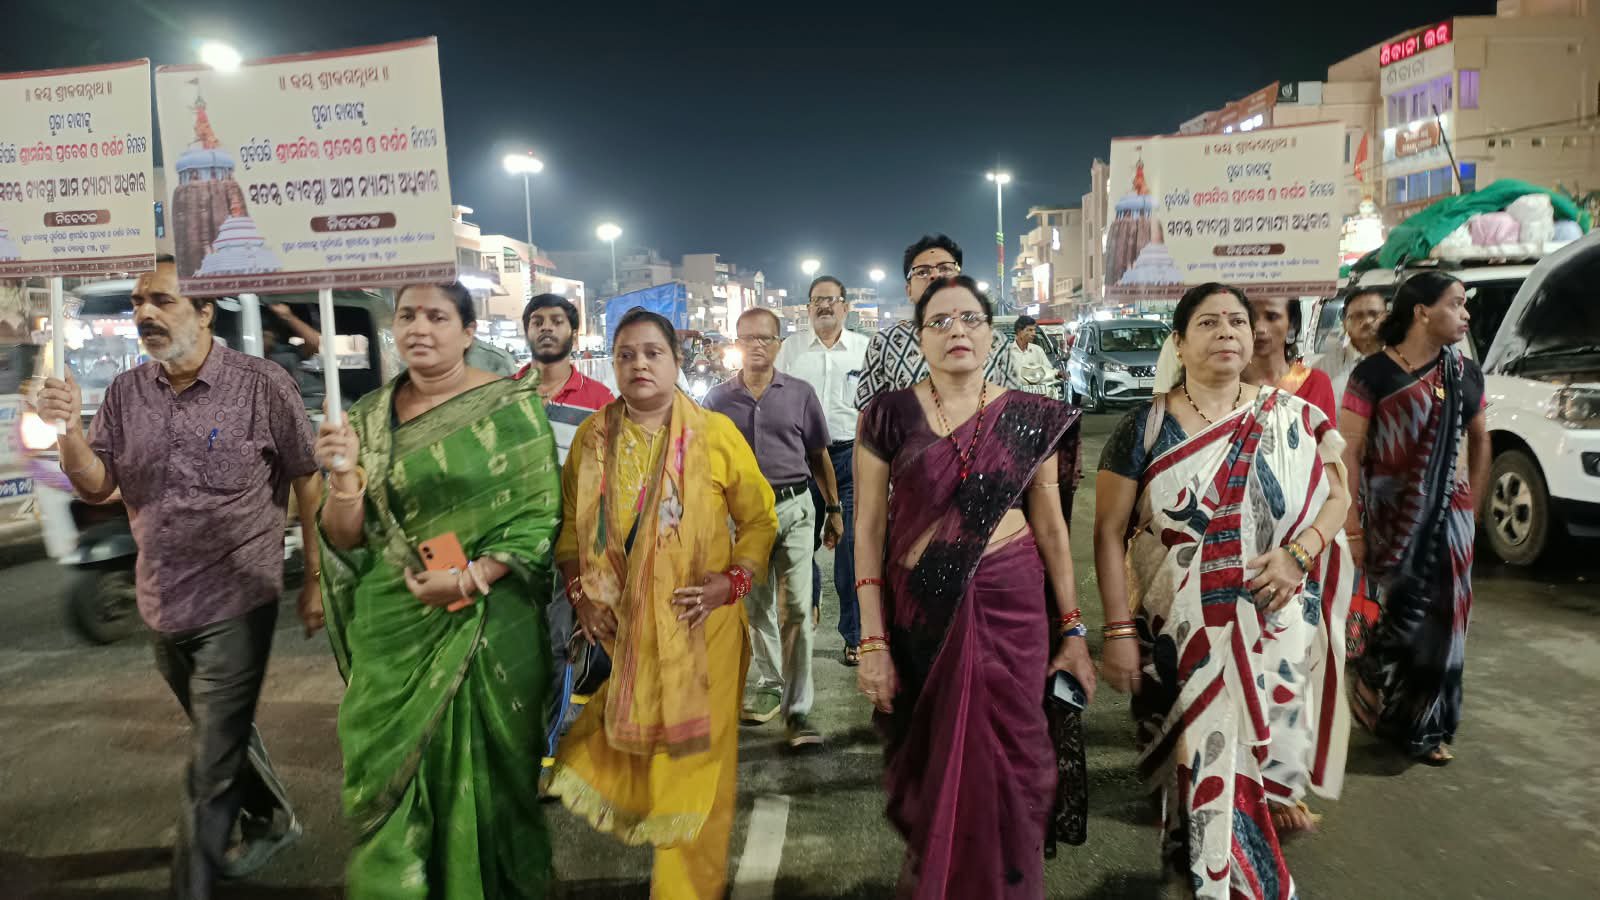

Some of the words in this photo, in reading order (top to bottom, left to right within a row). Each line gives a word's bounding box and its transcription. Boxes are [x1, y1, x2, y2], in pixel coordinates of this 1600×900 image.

[90, 142, 98, 158] ଓ
[366, 136, 376, 152] ଓ
[60, 177, 79, 197] ଆମ
[330, 176, 355, 199] ଆମ
[56, 212, 97, 225] ନିବେଦକ
